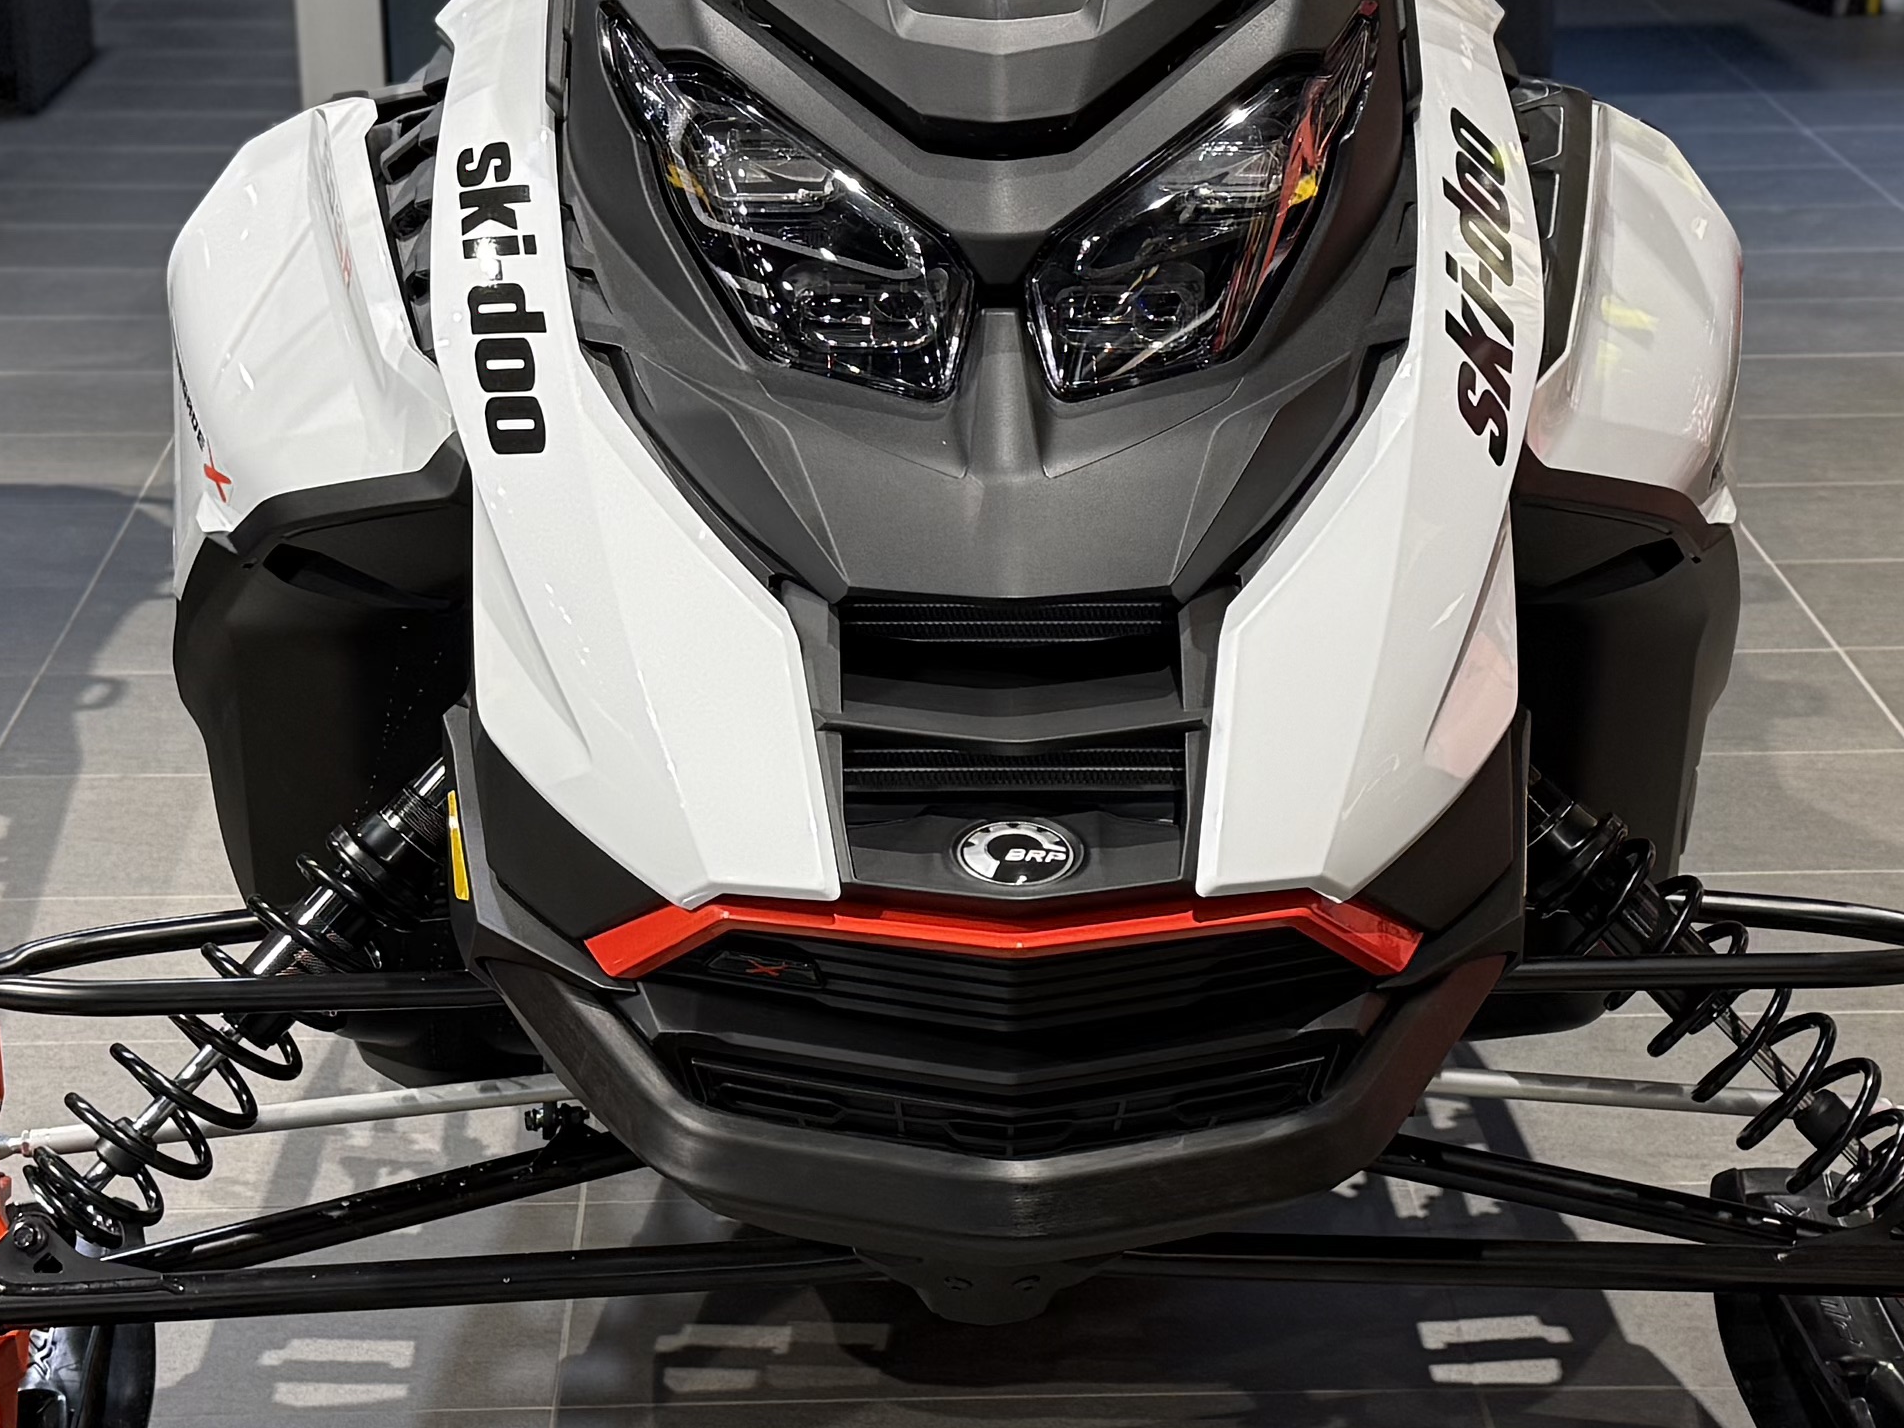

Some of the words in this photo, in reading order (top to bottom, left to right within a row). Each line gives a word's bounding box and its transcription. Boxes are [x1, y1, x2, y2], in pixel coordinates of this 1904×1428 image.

[457, 141, 547, 454] ski-doo
[1441, 107, 1515, 466] ski-doo
[1004, 848, 1067, 863] BRP
